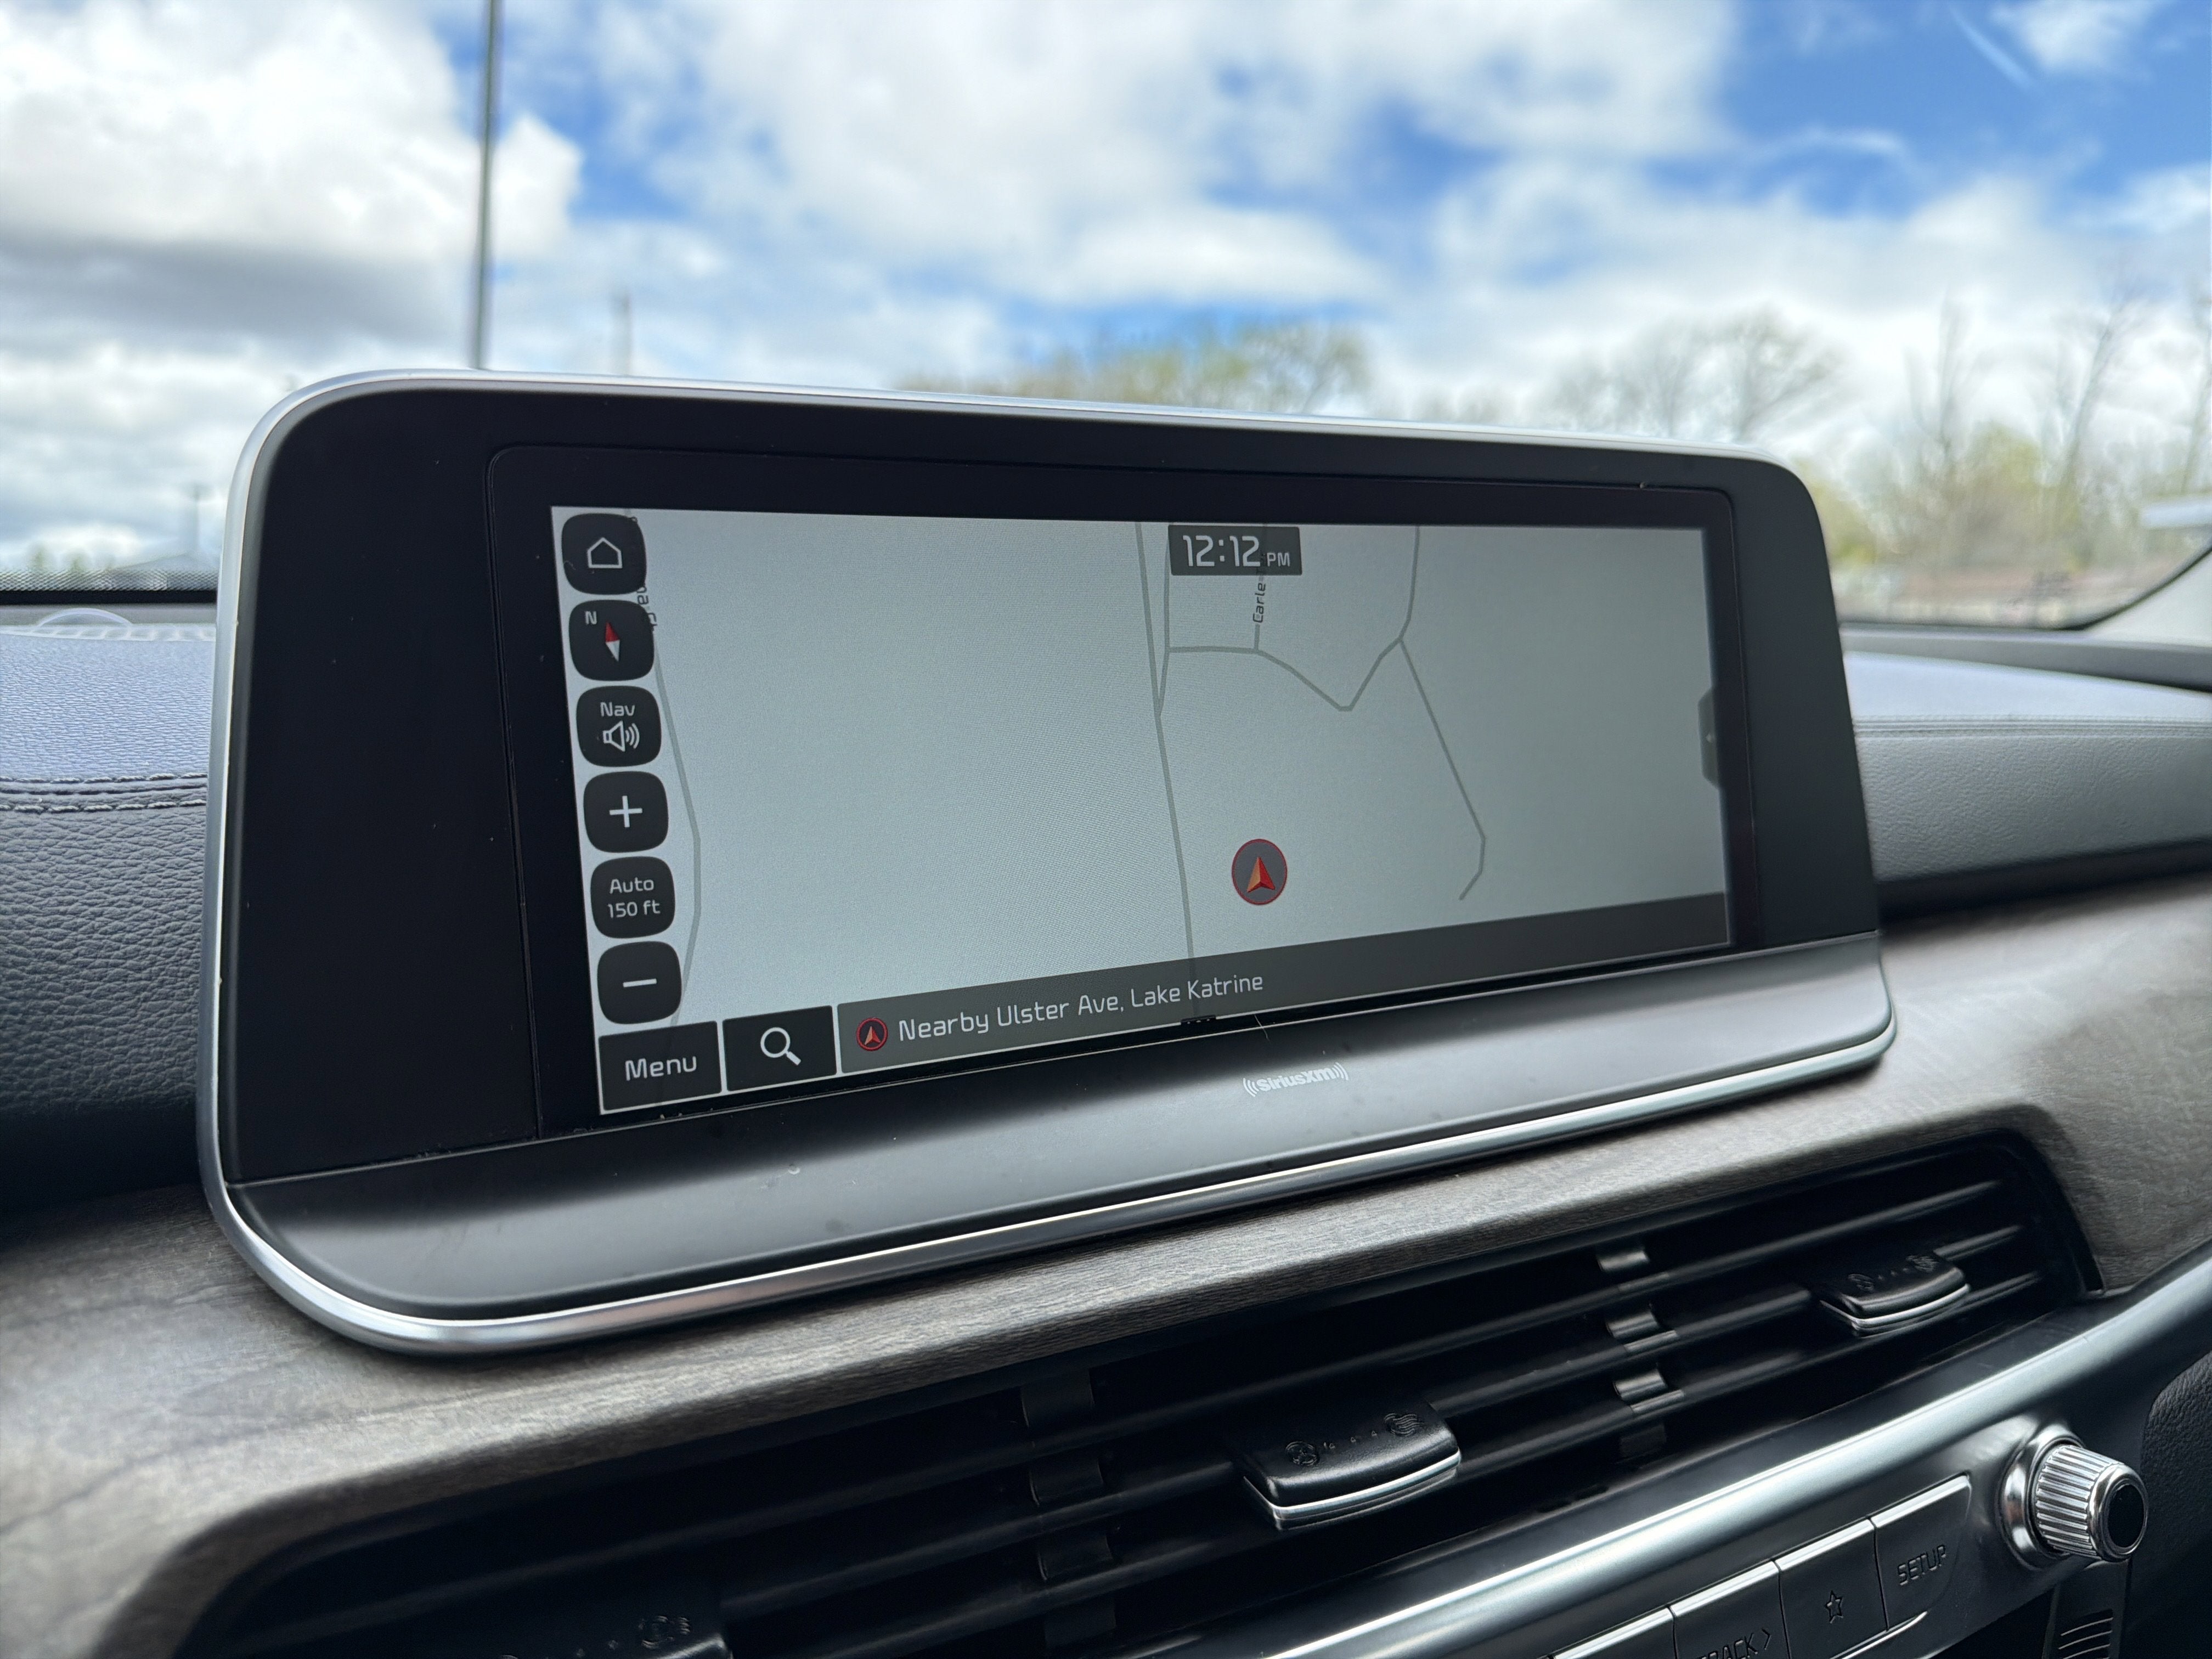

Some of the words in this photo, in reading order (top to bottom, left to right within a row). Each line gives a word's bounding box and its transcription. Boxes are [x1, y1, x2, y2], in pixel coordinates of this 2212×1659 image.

[1183, 535, 1261, 567] 12:12
[1267, 552, 1290, 567] PM
[1253, 583, 1266, 623] Carle
[585, 611, 597, 625] N
[600, 702, 635, 717] Nav
[609, 878, 654, 894] Auto
[607, 901, 638, 919] 150
[643, 899, 661, 916] ft
[899, 1012, 989, 1042] Nearby
[997, 1001, 1070, 1027] Ulster
[1077, 995, 1124, 1015] Ave,
[1131, 985, 1181, 1008] Lake
[1187, 974, 1263, 1000] Katrine
[624, 1056, 697, 1081] Menu
[1897, 1544, 1947, 1586] SETUP
